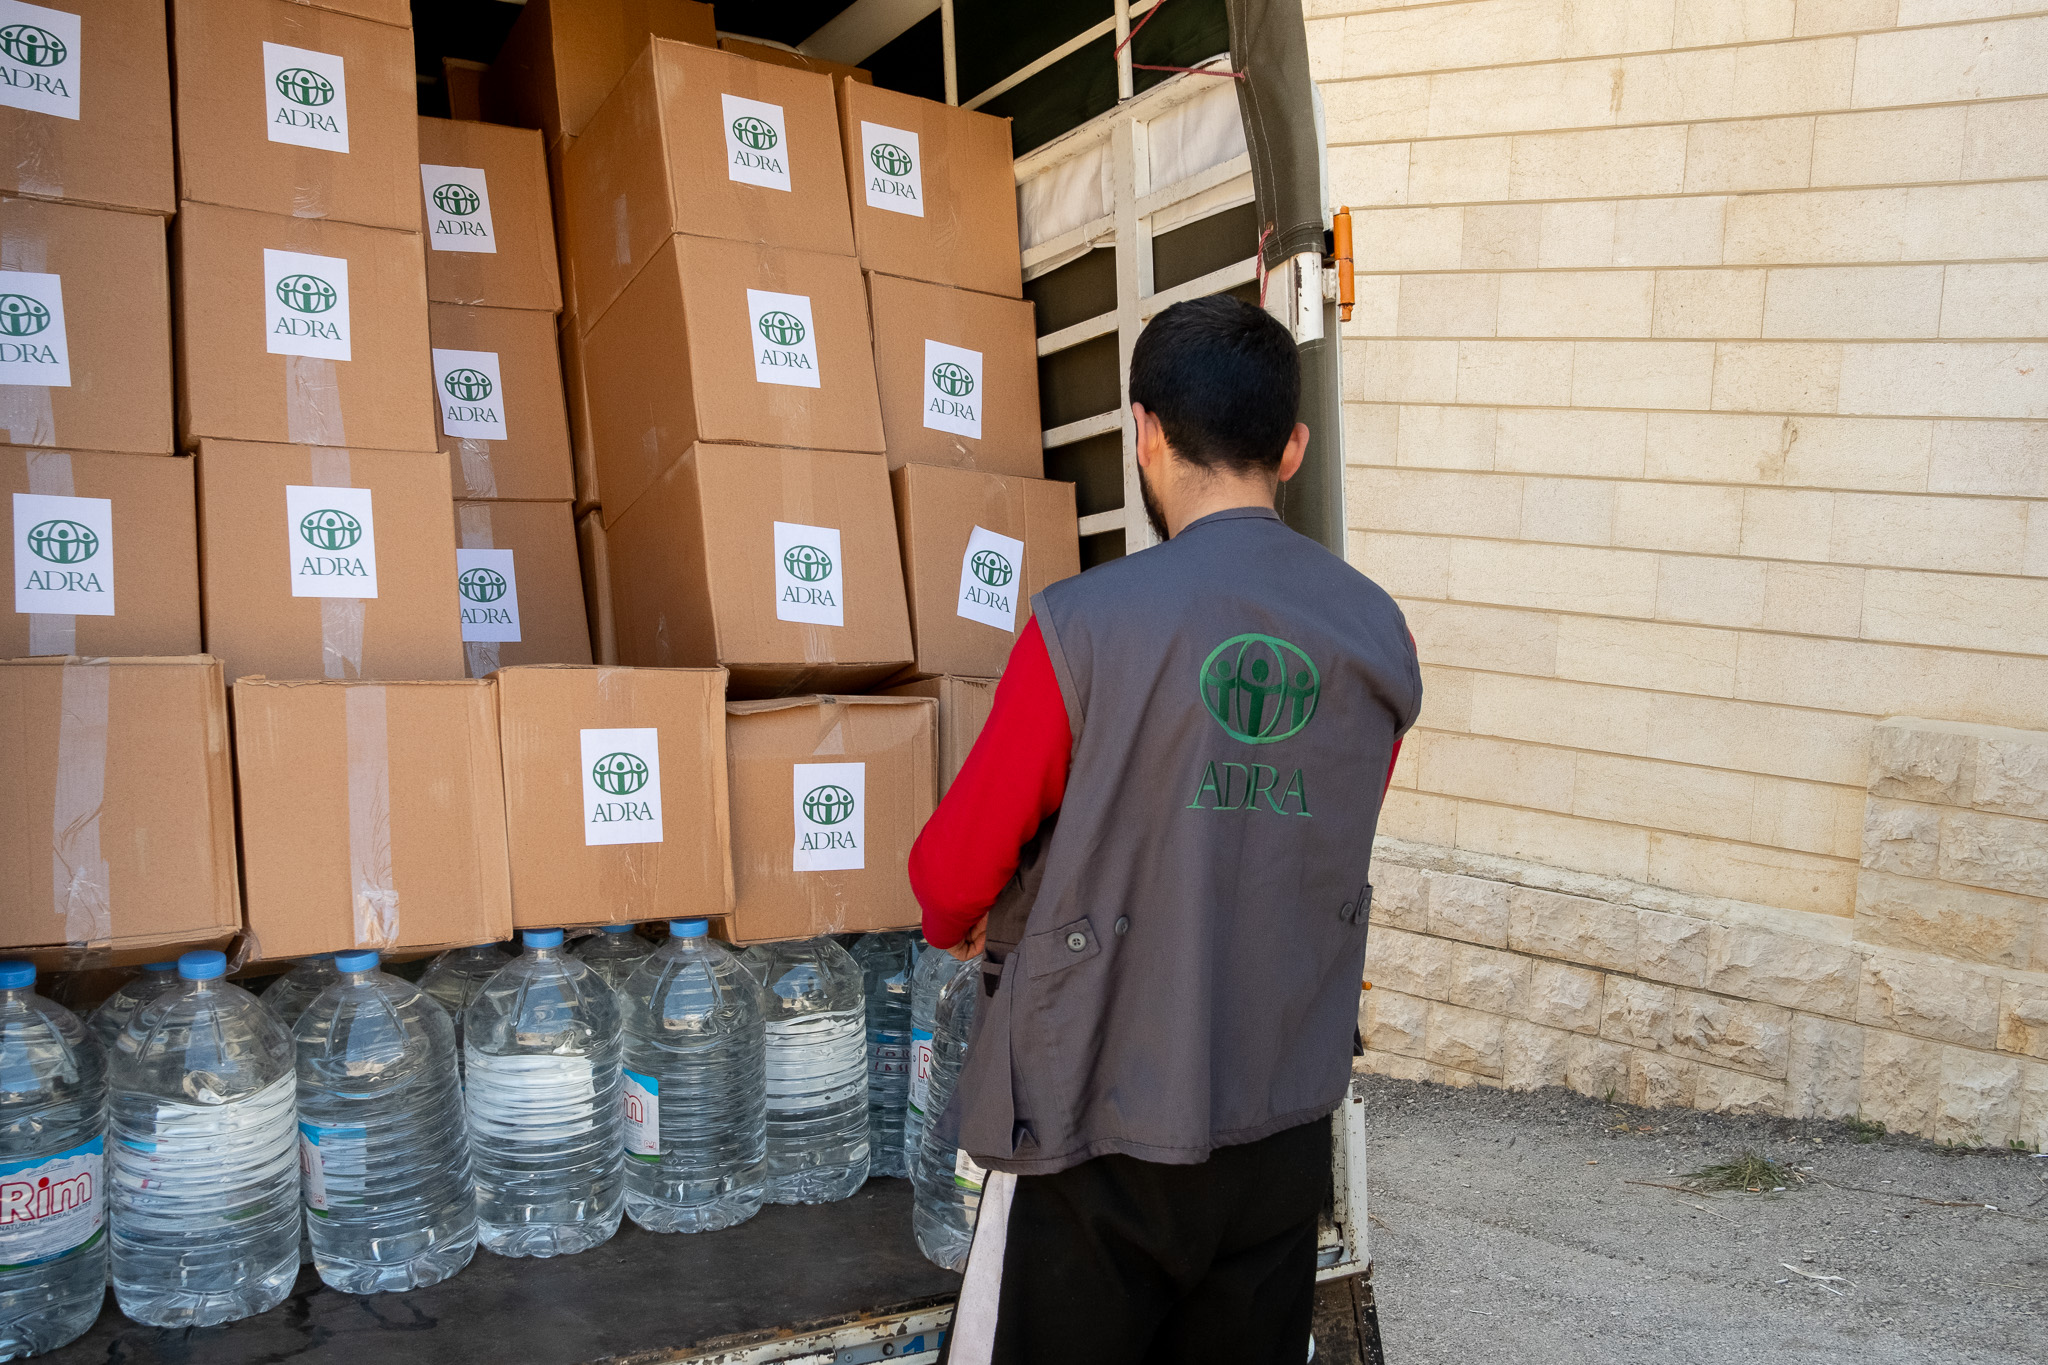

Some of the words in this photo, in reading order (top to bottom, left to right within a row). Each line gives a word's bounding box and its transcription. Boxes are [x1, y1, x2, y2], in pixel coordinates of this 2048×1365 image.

[0, 66, 71, 98] ADRA
[274, 106, 340, 134] ADRA
[733, 150, 784, 174] ADRA
[871, 177, 917, 200] ADRA
[434, 219, 488, 237] ADRA
[274, 316, 342, 341] ADRA
[0, 342, 60, 364] DRA
[760, 349, 813, 370] ADRA
[447, 405, 499, 423] ADRA
[929, 397, 977, 422] ADRA
[299, 556, 369, 577] ADRA
[23, 569, 105, 593] ADRA
[782, 585, 837, 607] ADRA
[964, 585, 1011, 614] ADRA
[461, 608, 513, 624] ADRA
[1186, 760, 1312, 817] ADRA
[591, 801, 654, 823] ADRA
[800, 830, 858, 850] ADRA
[0, 1172, 92, 1225] Rim
[40, 1210, 71, 1223] MINERAL
